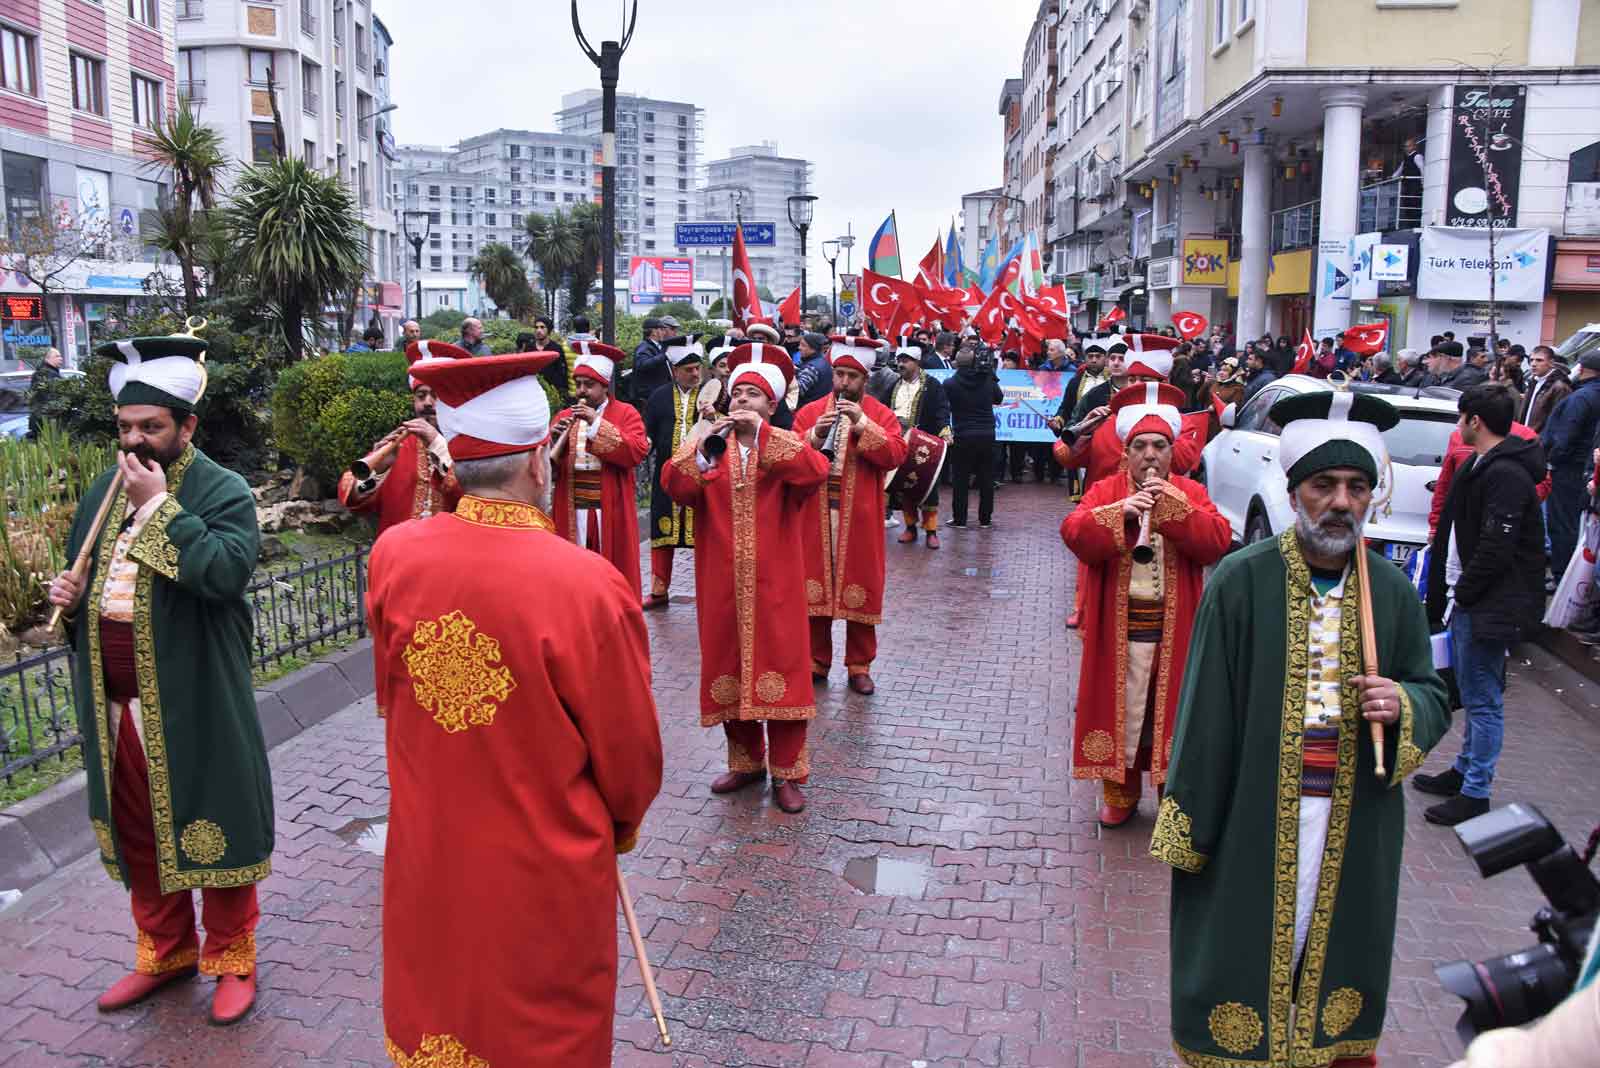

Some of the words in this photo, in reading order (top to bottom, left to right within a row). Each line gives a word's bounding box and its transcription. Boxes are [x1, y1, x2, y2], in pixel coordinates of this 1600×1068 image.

[1186, 253, 1224, 276] ŞOK
[1427, 256, 1455, 268] Türk
[1459, 257, 1513, 270] Telekom
[1397, 545, 1409, 559] 17
